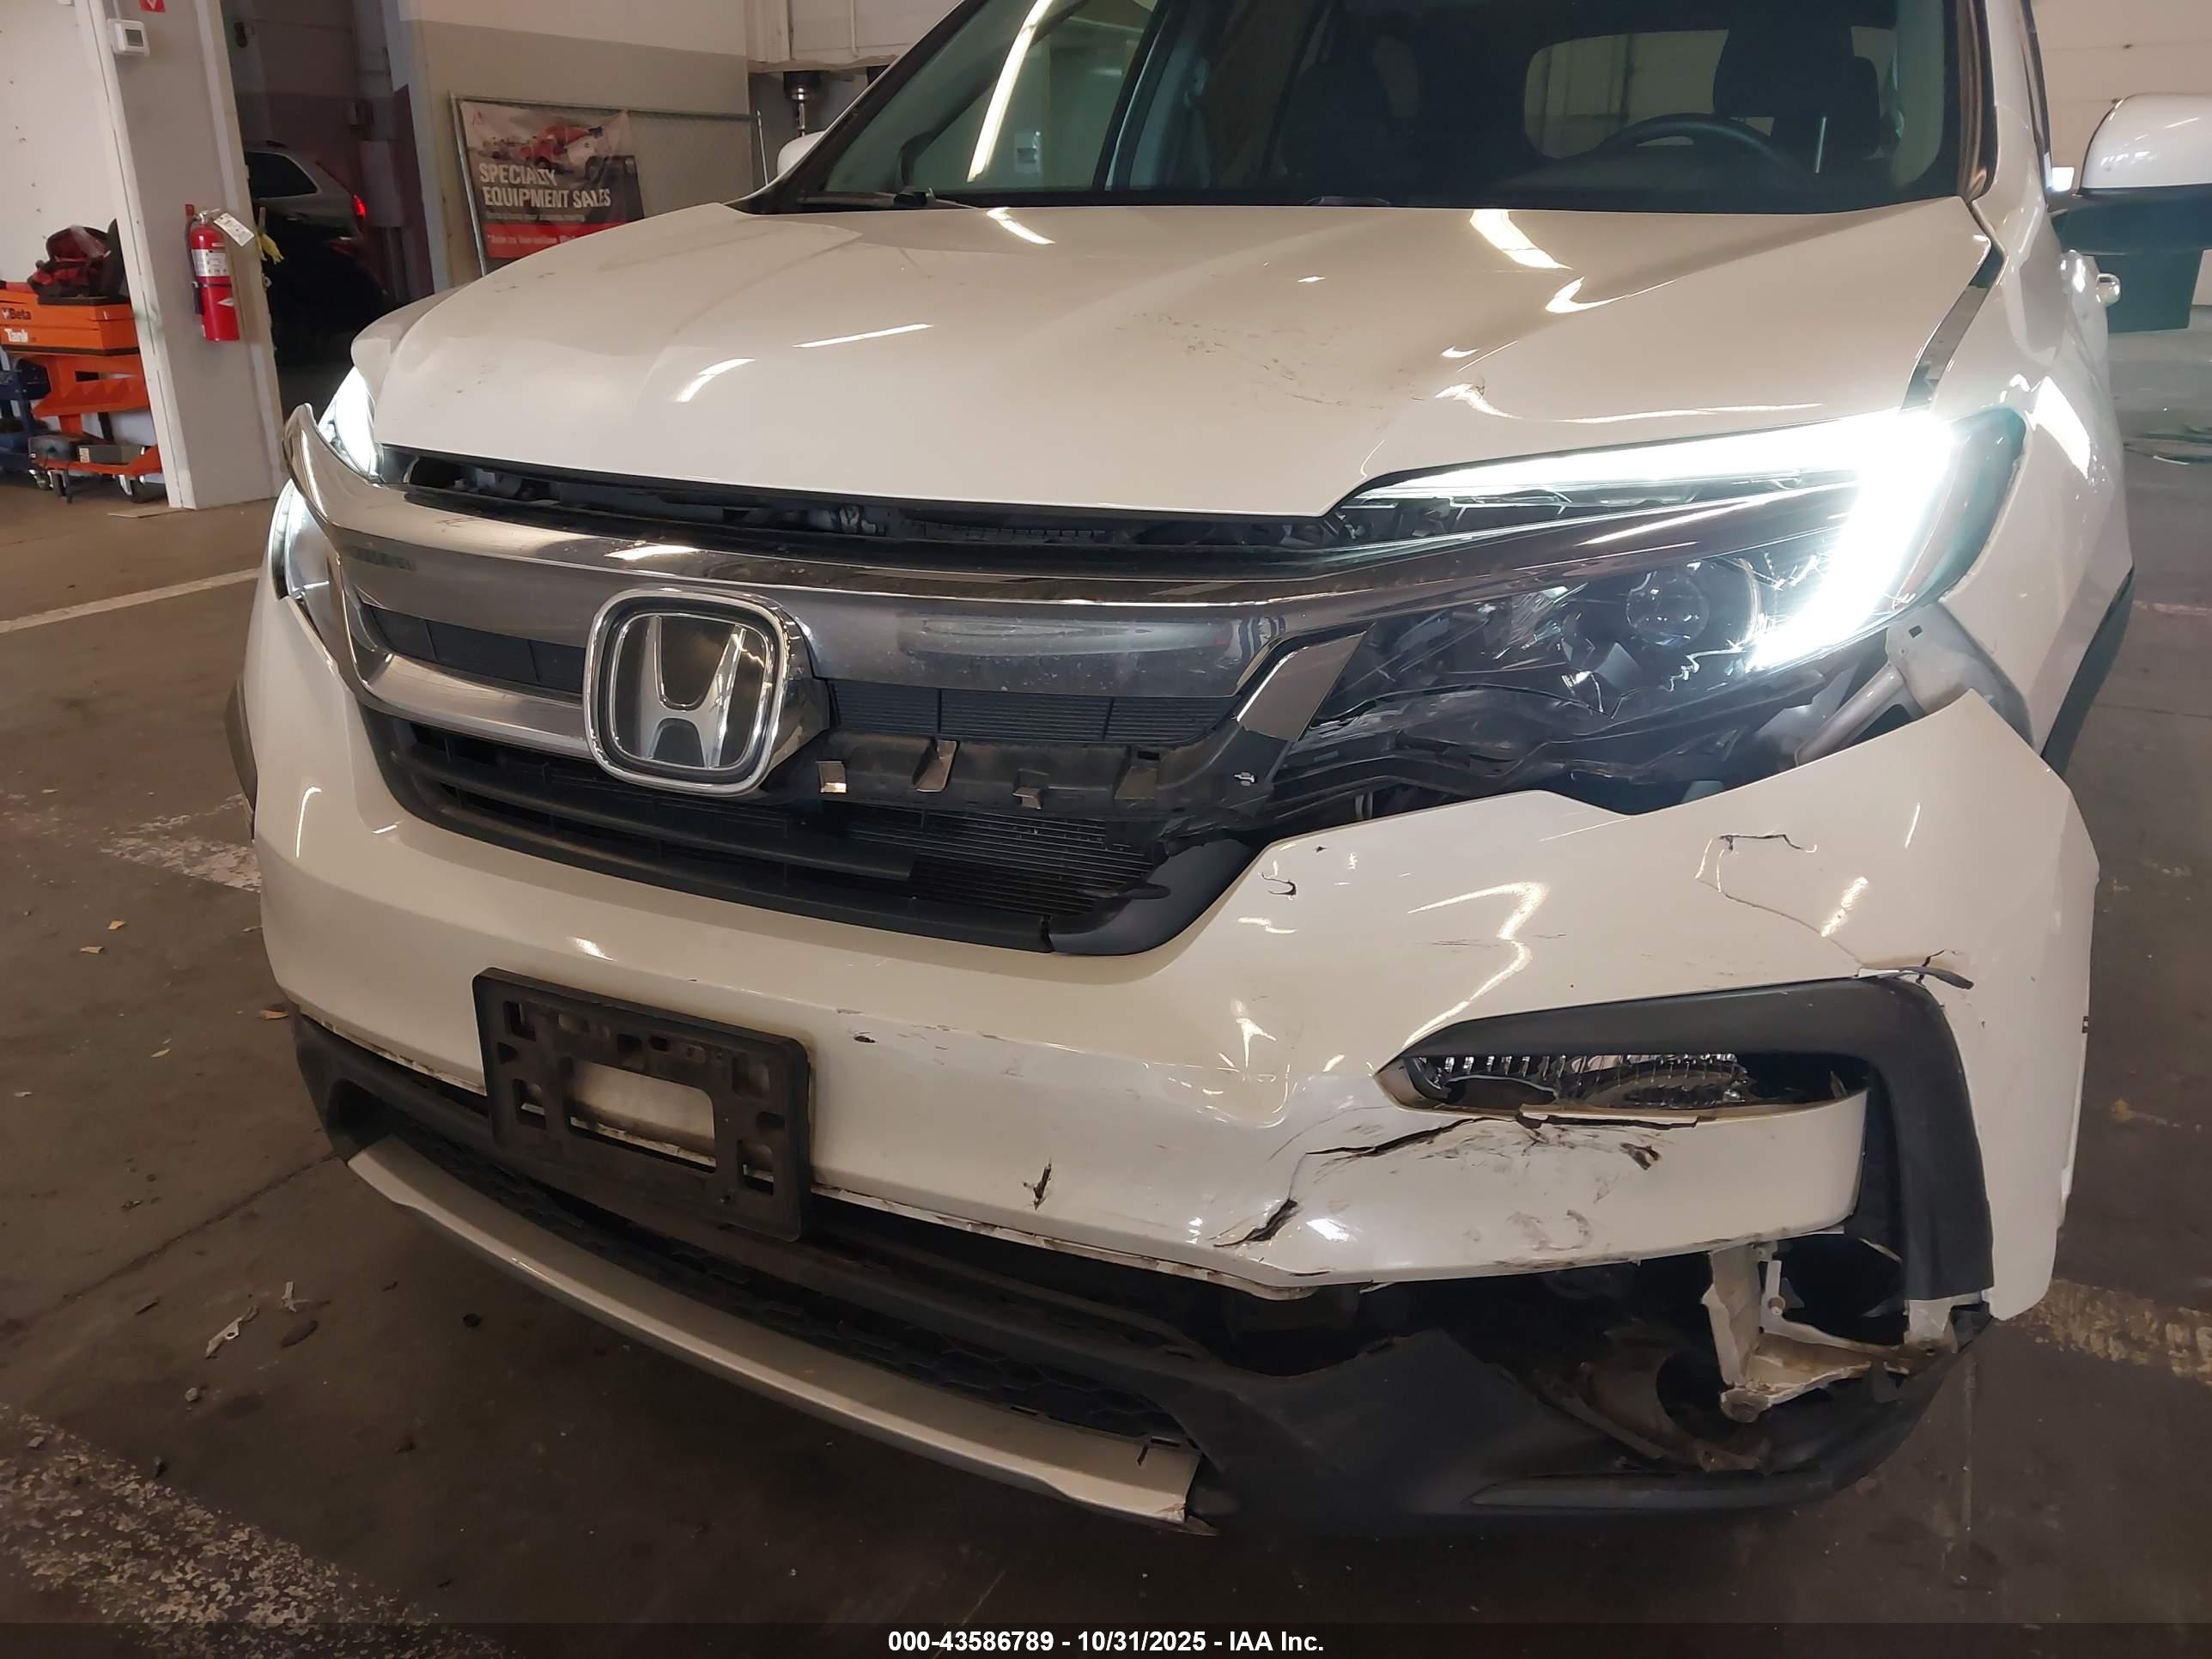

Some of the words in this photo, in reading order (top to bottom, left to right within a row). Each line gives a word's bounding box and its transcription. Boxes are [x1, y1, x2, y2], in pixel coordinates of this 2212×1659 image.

[479, 163, 557, 186] SPECIALTY
[483, 186, 569, 208] EQUIPMENT
[573, 188, 611, 209] SALES
